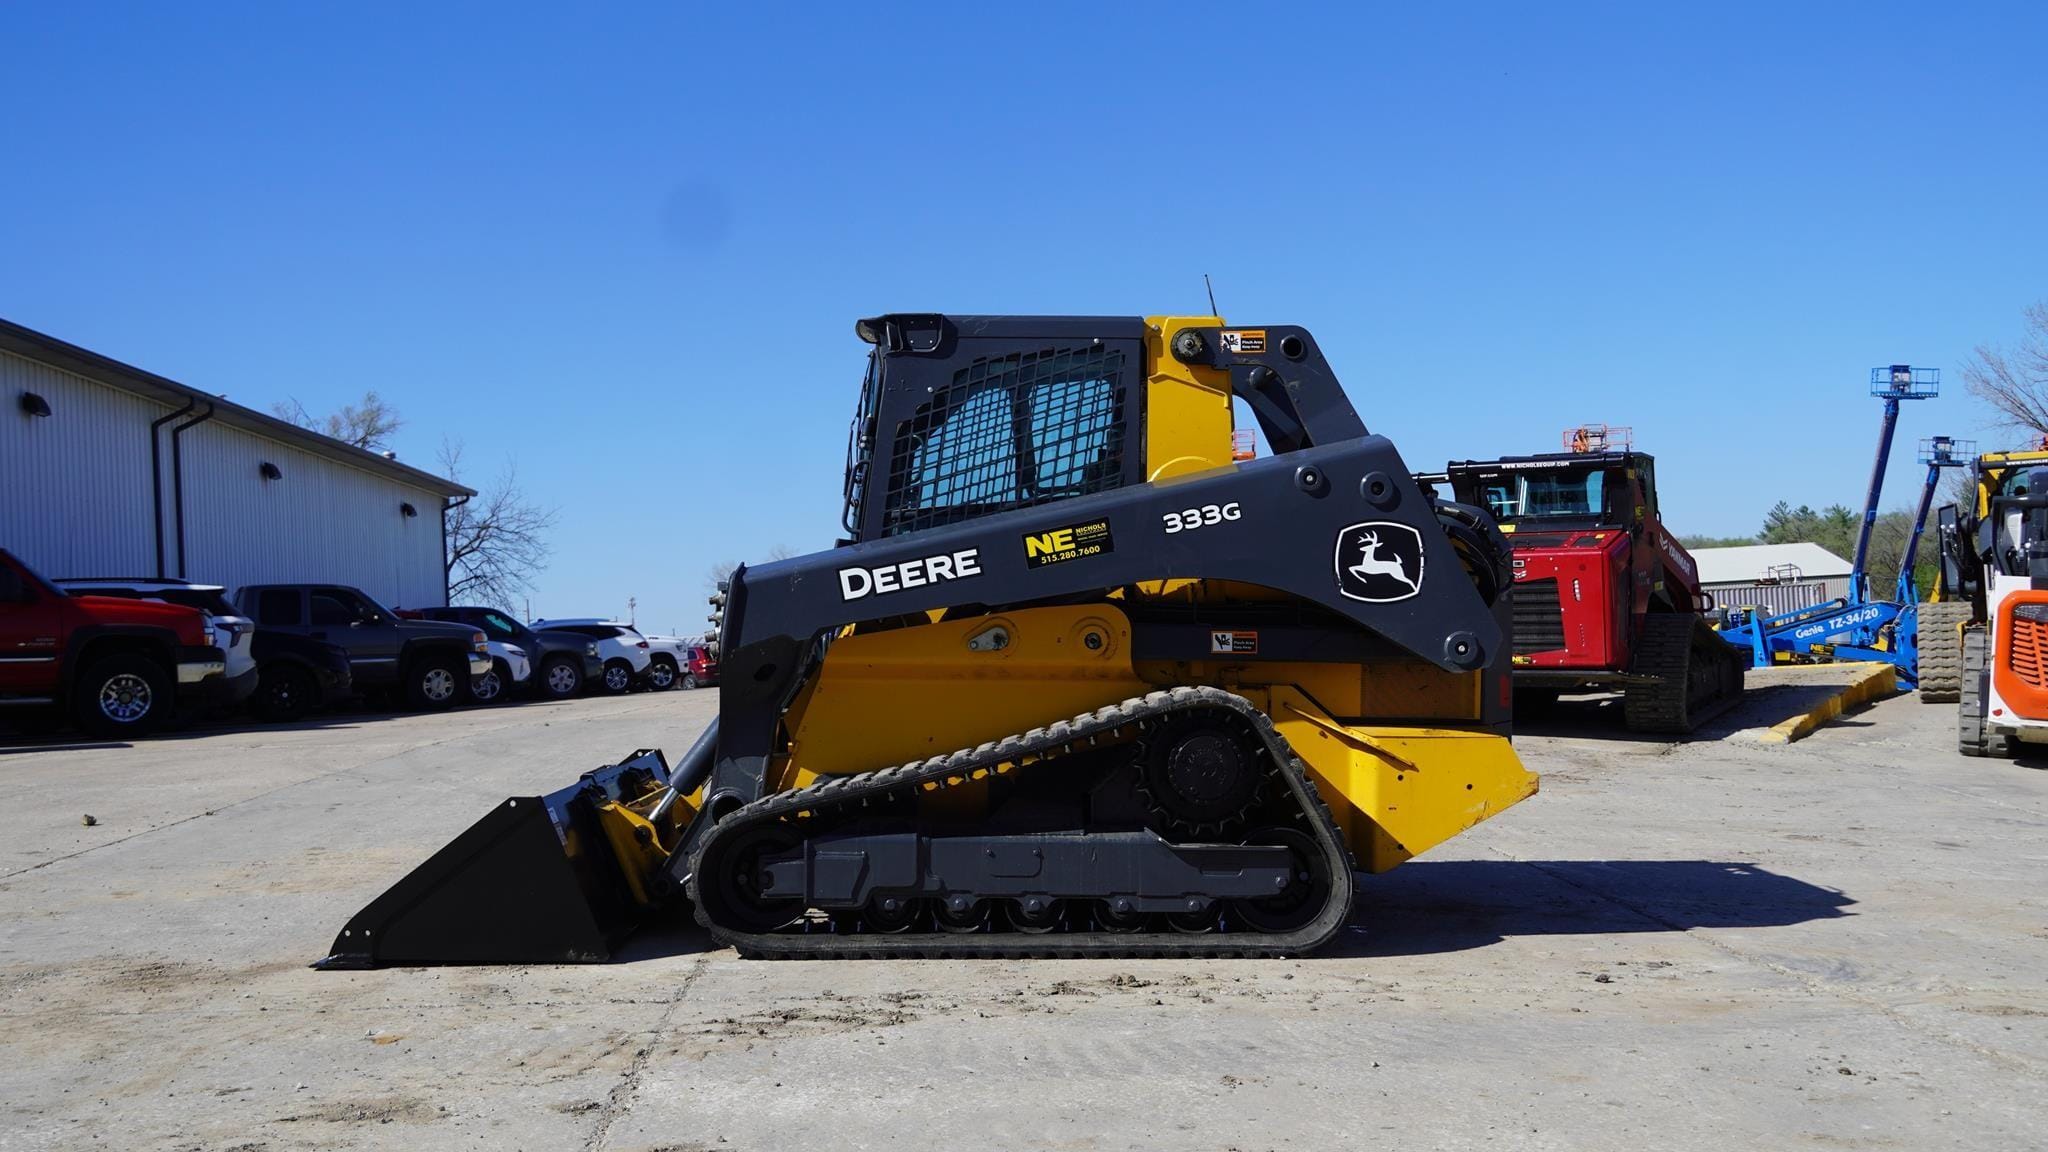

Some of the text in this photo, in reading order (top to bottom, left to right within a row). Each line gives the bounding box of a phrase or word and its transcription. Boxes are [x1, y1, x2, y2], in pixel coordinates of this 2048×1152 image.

[1075, 522, 1107, 534] NICHOLS
[1163, 502, 1242, 533] 333G
[1025, 528, 1076, 558] NE
[1041, 545, 1101, 564] 515.280.7600
[839, 549, 981, 600] DEERE
[1795, 607, 1879, 639] Genie TZ-34/20
